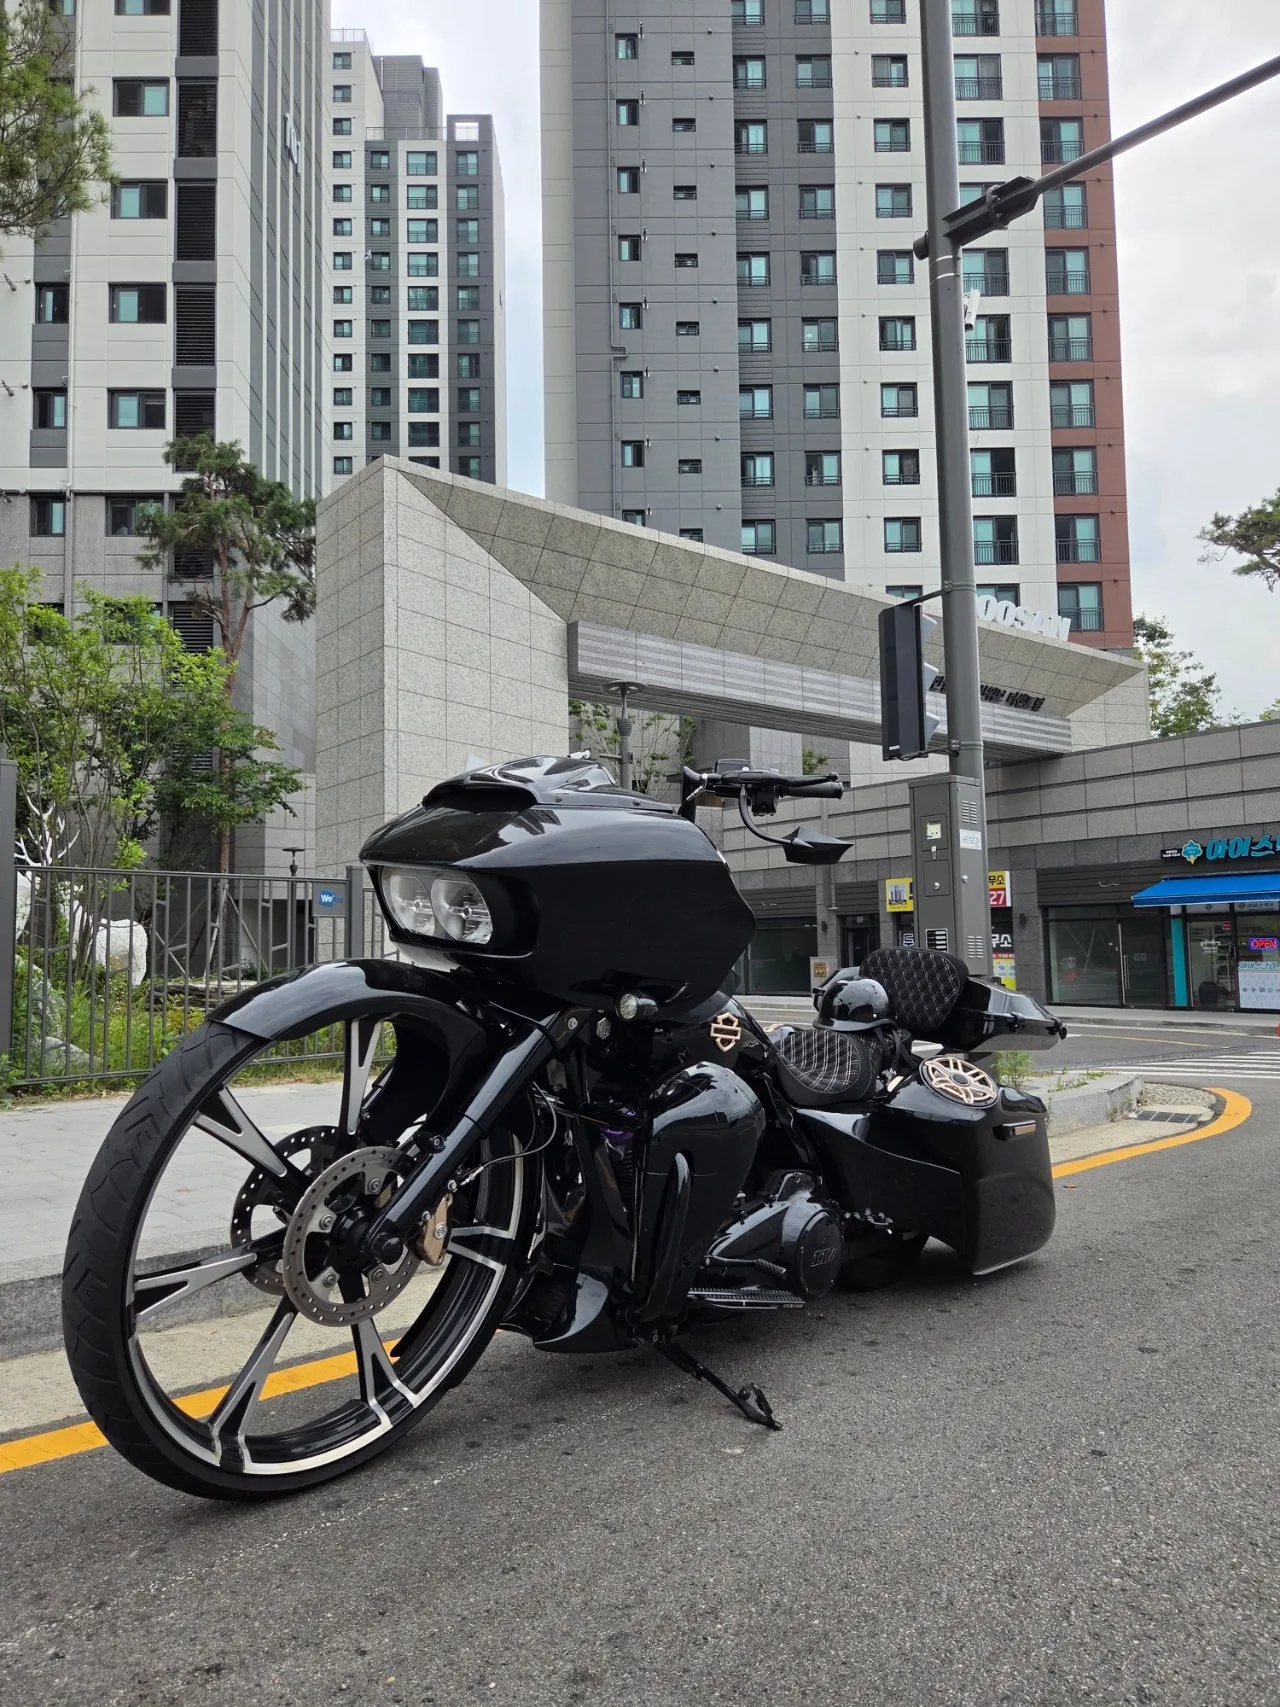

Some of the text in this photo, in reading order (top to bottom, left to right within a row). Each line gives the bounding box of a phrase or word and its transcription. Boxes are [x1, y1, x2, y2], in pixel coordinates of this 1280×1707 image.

[975, 594, 1071, 641] OOSAN
[1205, 834, 1280, 860] 아이스
[989, 890, 1006, 905] 27
[1252, 939, 1276, 949] OPEN
